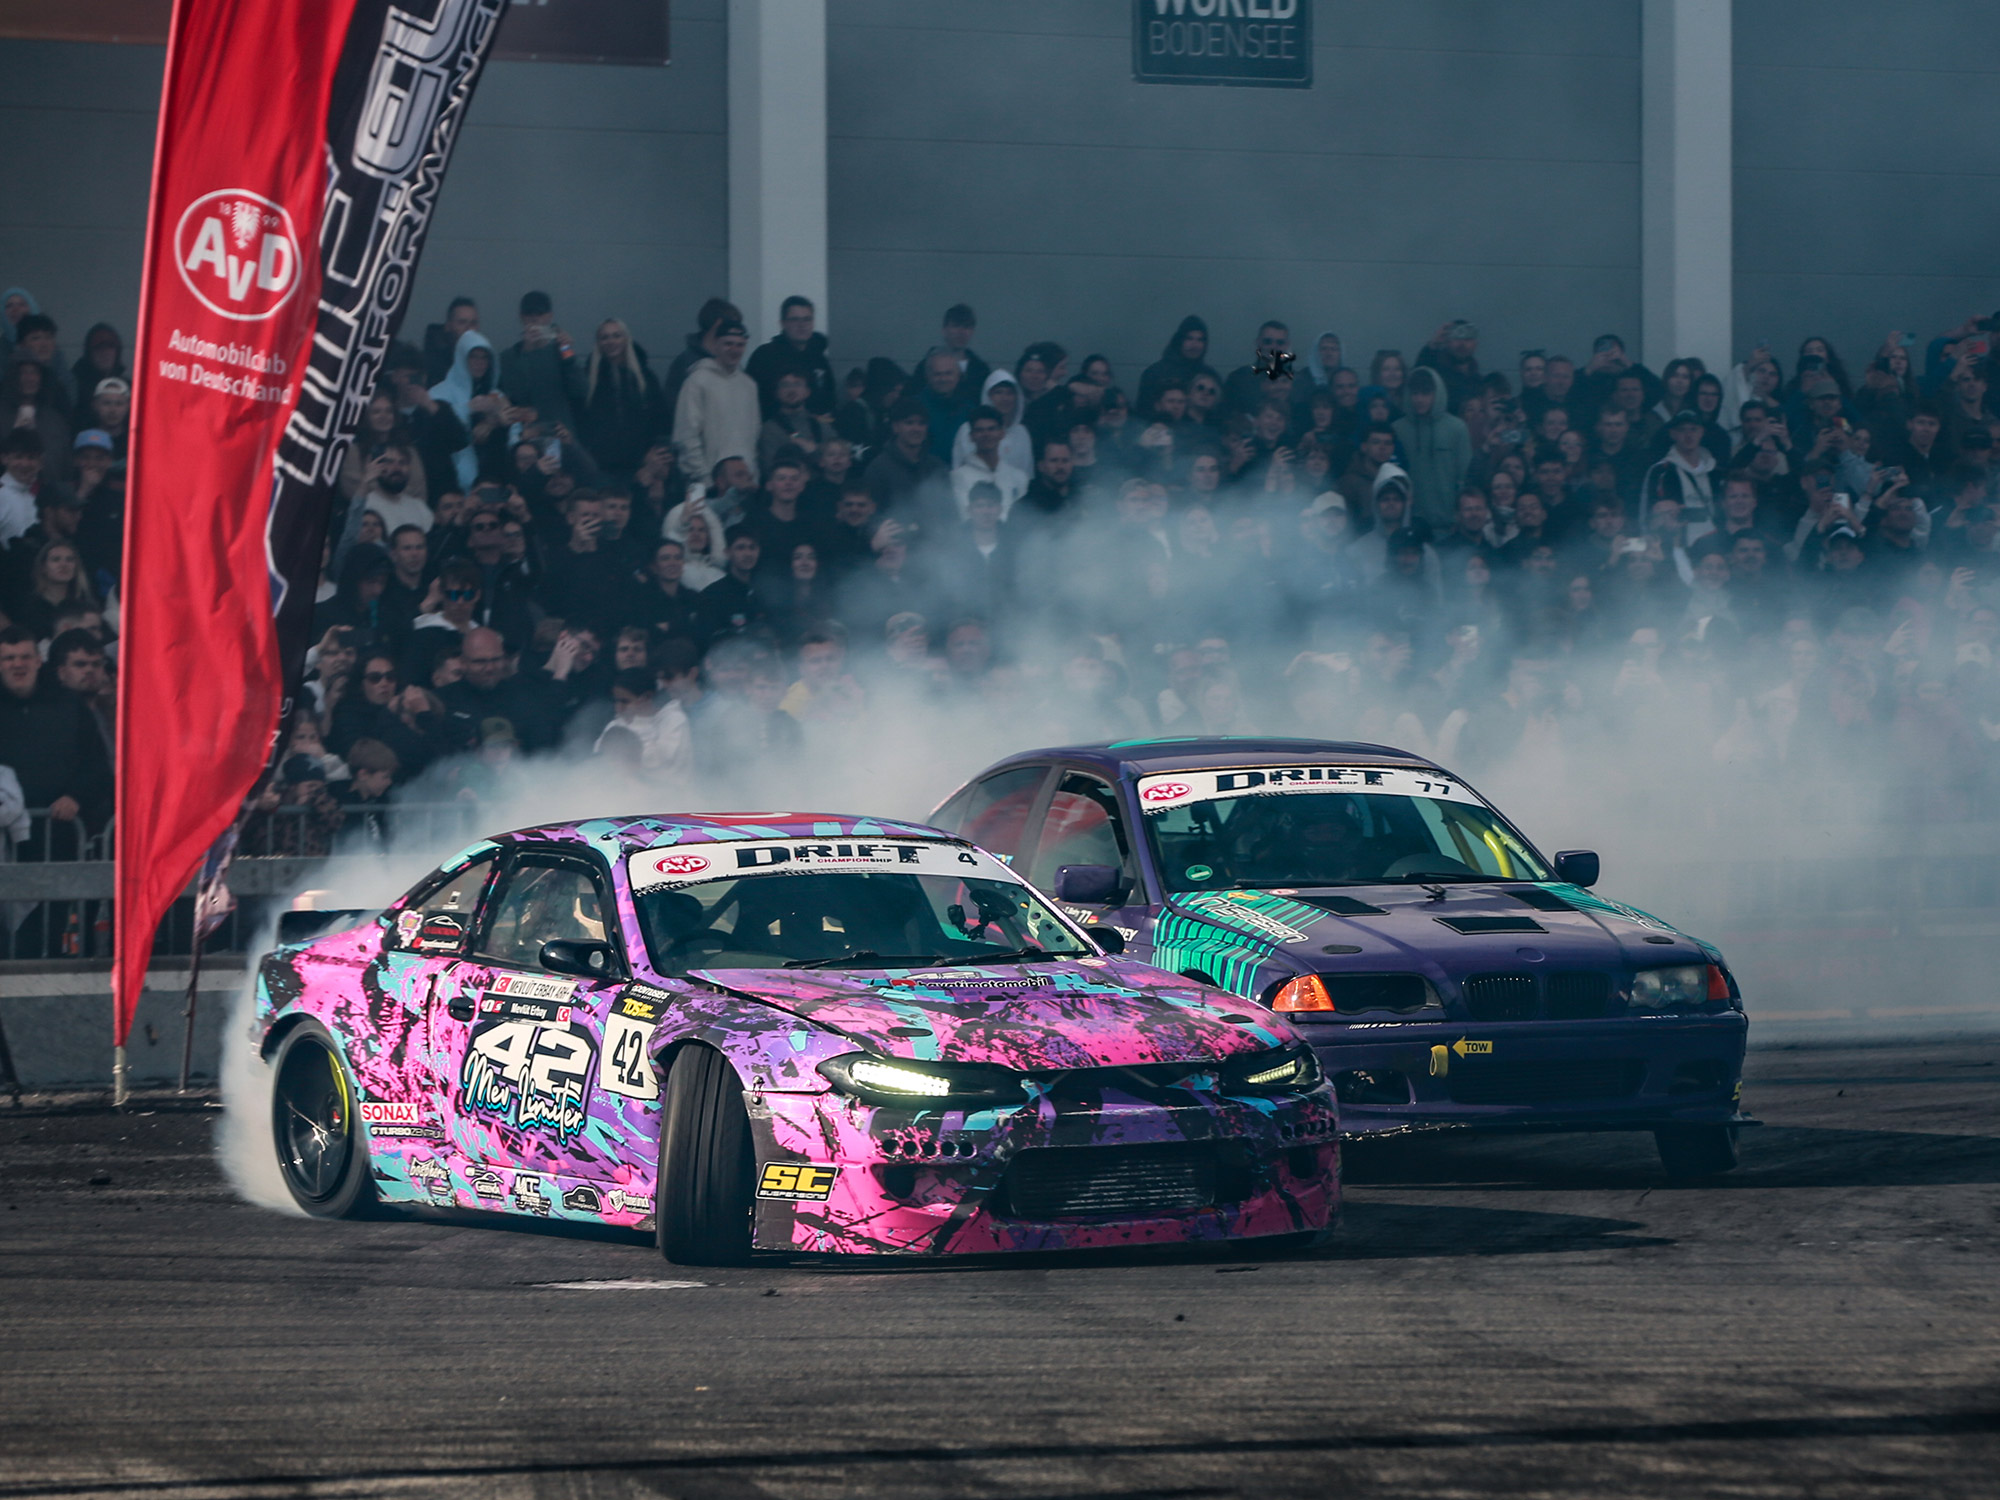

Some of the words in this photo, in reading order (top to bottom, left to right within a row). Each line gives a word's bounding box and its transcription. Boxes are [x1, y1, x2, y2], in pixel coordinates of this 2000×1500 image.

[1149, 20, 1296, 59] BODENSEE
[159, 360, 187, 382] von
[191, 363, 293, 405] Deutschland
[1216, 769, 1394, 793] DRIFT
[1415, 780, 1451, 795] 77
[735, 844, 930, 869] DRIFT
[957, 852, 978, 866] 4
[508, 979, 536, 995] MEVLÜT
[534, 983, 557, 999] ERBAY
[473, 1022, 592, 1096] 42
[612, 1028, 644, 1088] 42
[1465, 1042, 1488, 1052] TOW
[362, 1105, 414, 1121] SONAX
